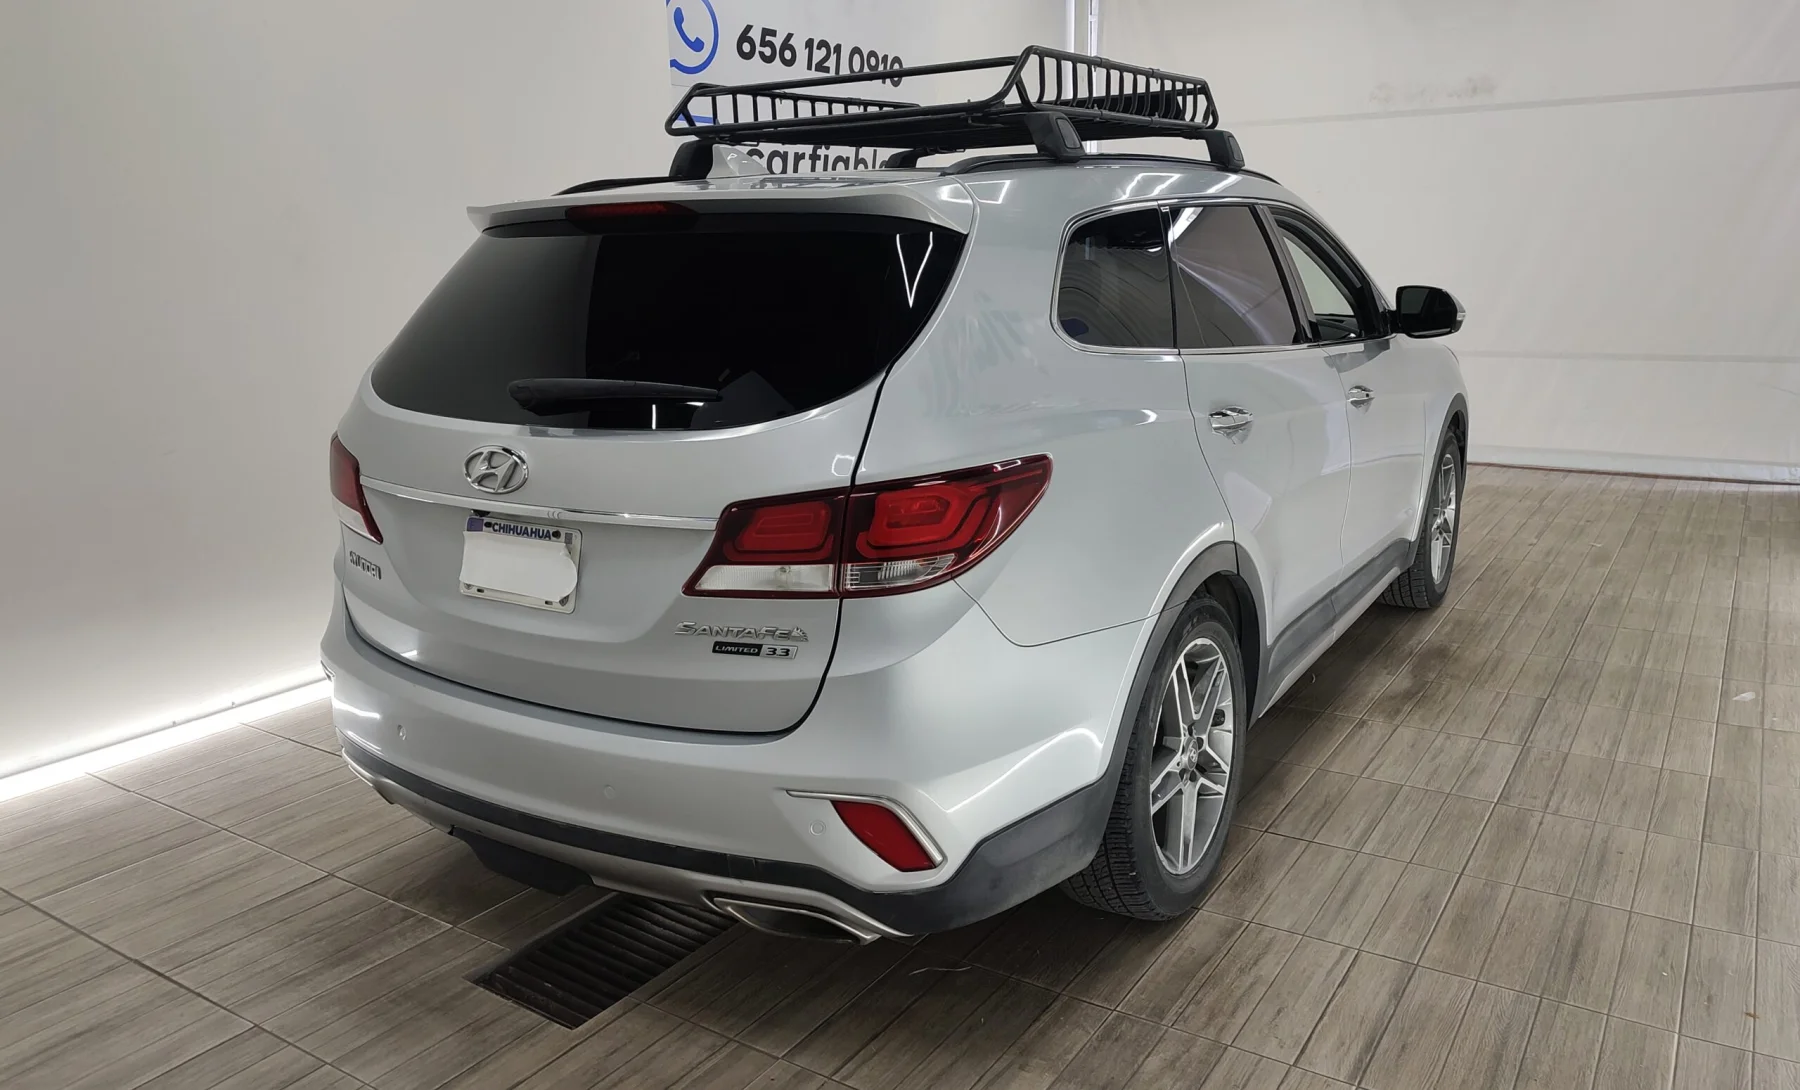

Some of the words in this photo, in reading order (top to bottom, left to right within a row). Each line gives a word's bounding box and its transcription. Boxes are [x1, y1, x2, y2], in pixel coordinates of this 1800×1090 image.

[736, 24, 797, 67] 656
[804, 37, 842, 76] 121
[848, 45, 904, 88] 0910
[746, 145, 888, 174] arfiabl
[491, 522, 552, 540] CHIHUAHUA
[715, 645, 759, 654] LIMITED
